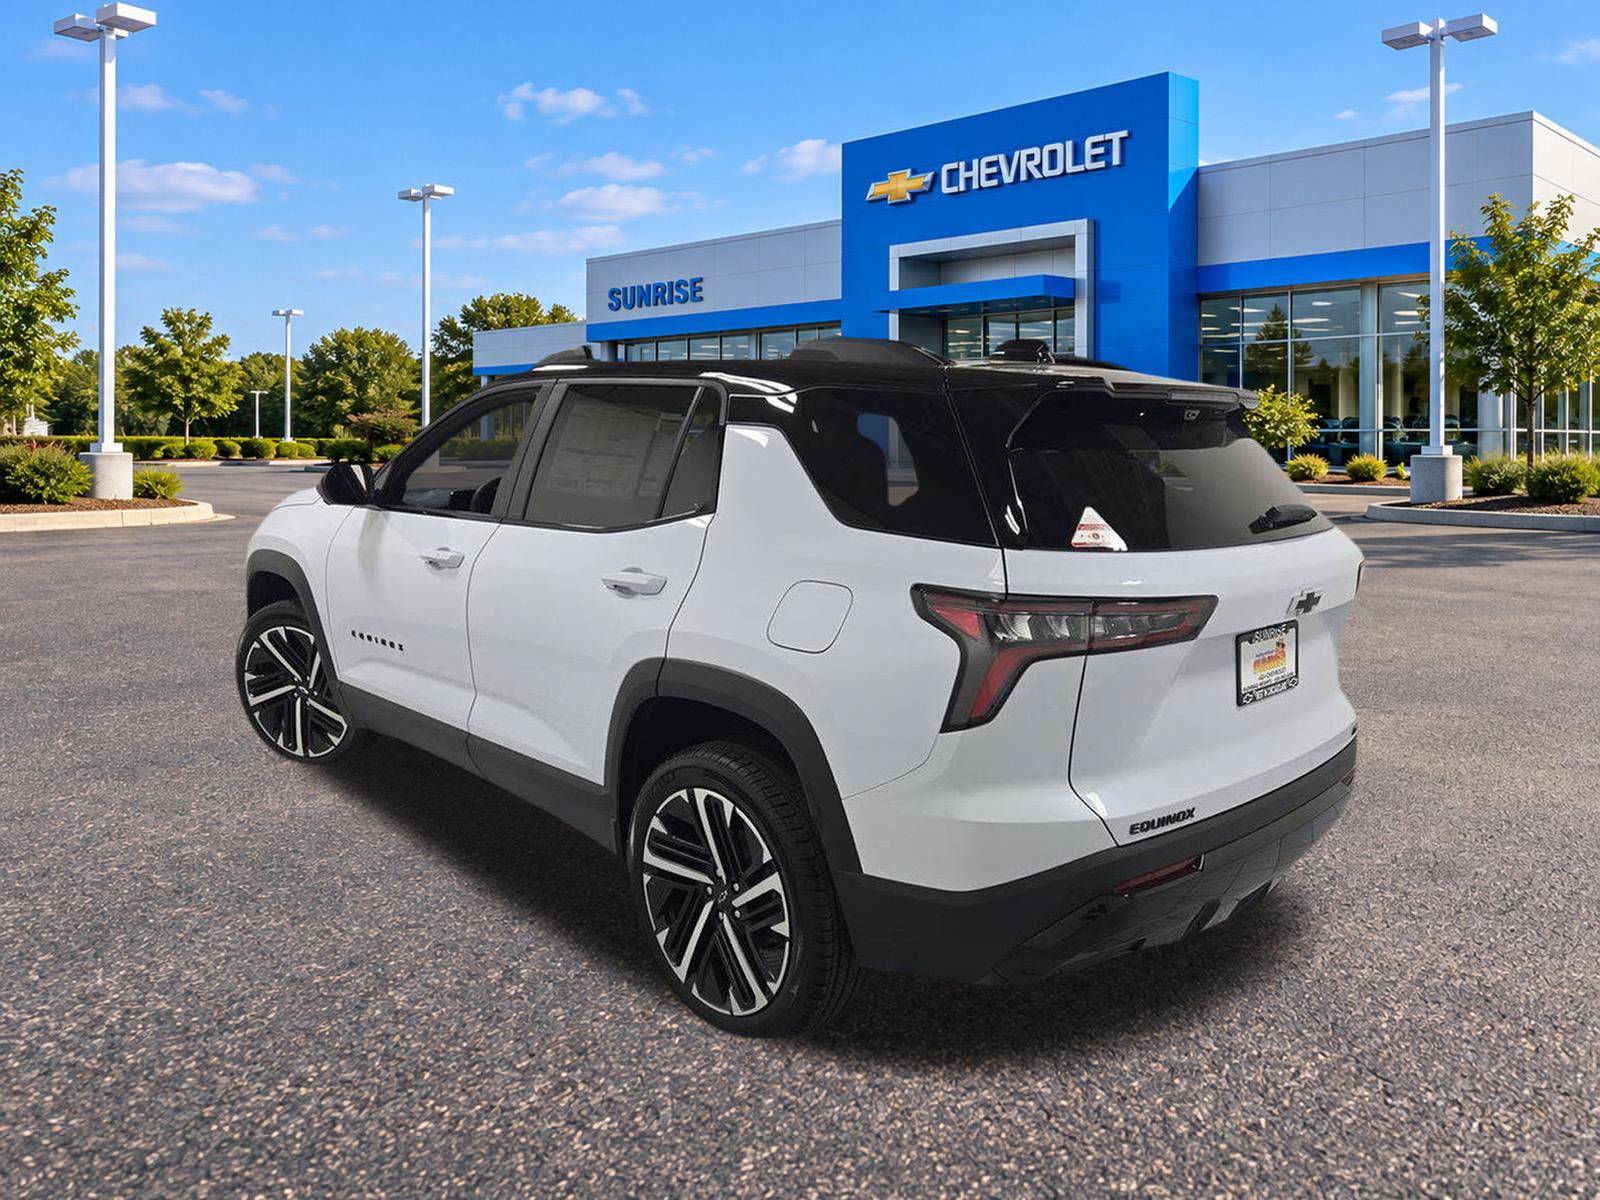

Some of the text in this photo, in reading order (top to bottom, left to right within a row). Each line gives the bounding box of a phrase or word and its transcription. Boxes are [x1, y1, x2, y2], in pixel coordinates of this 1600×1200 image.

[941, 130, 1129, 194] CHEVROLET
[608, 277, 704, 312] SUNRISE
[1128, 807, 1196, 836] EQUINOX
